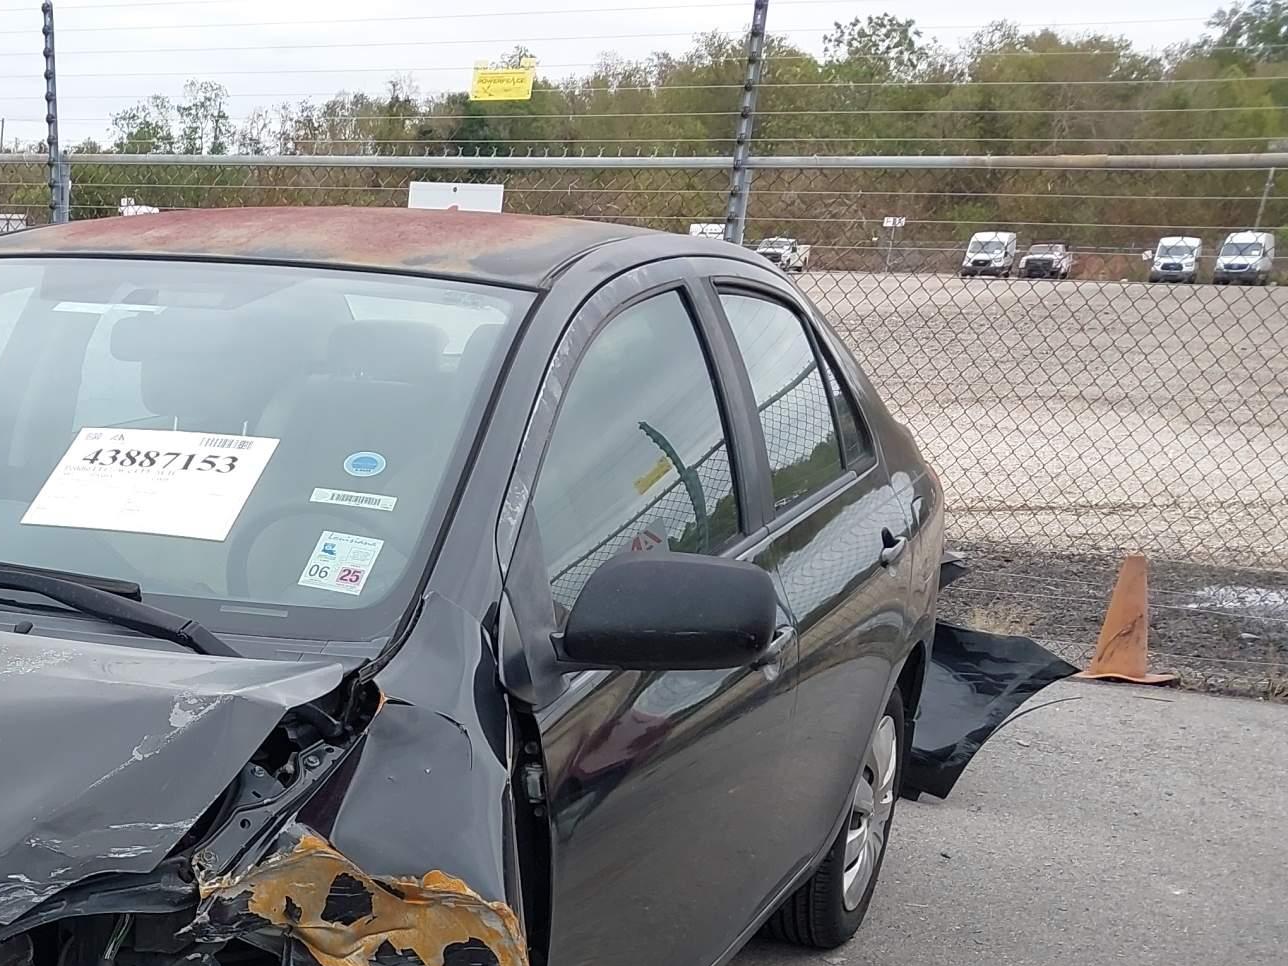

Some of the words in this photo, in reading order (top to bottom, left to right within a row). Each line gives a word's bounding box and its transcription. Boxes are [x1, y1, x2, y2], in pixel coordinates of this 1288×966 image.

[82, 447, 240, 474] 43887153
[308, 563, 331, 579] 06
[339, 568, 362, 583] 25
